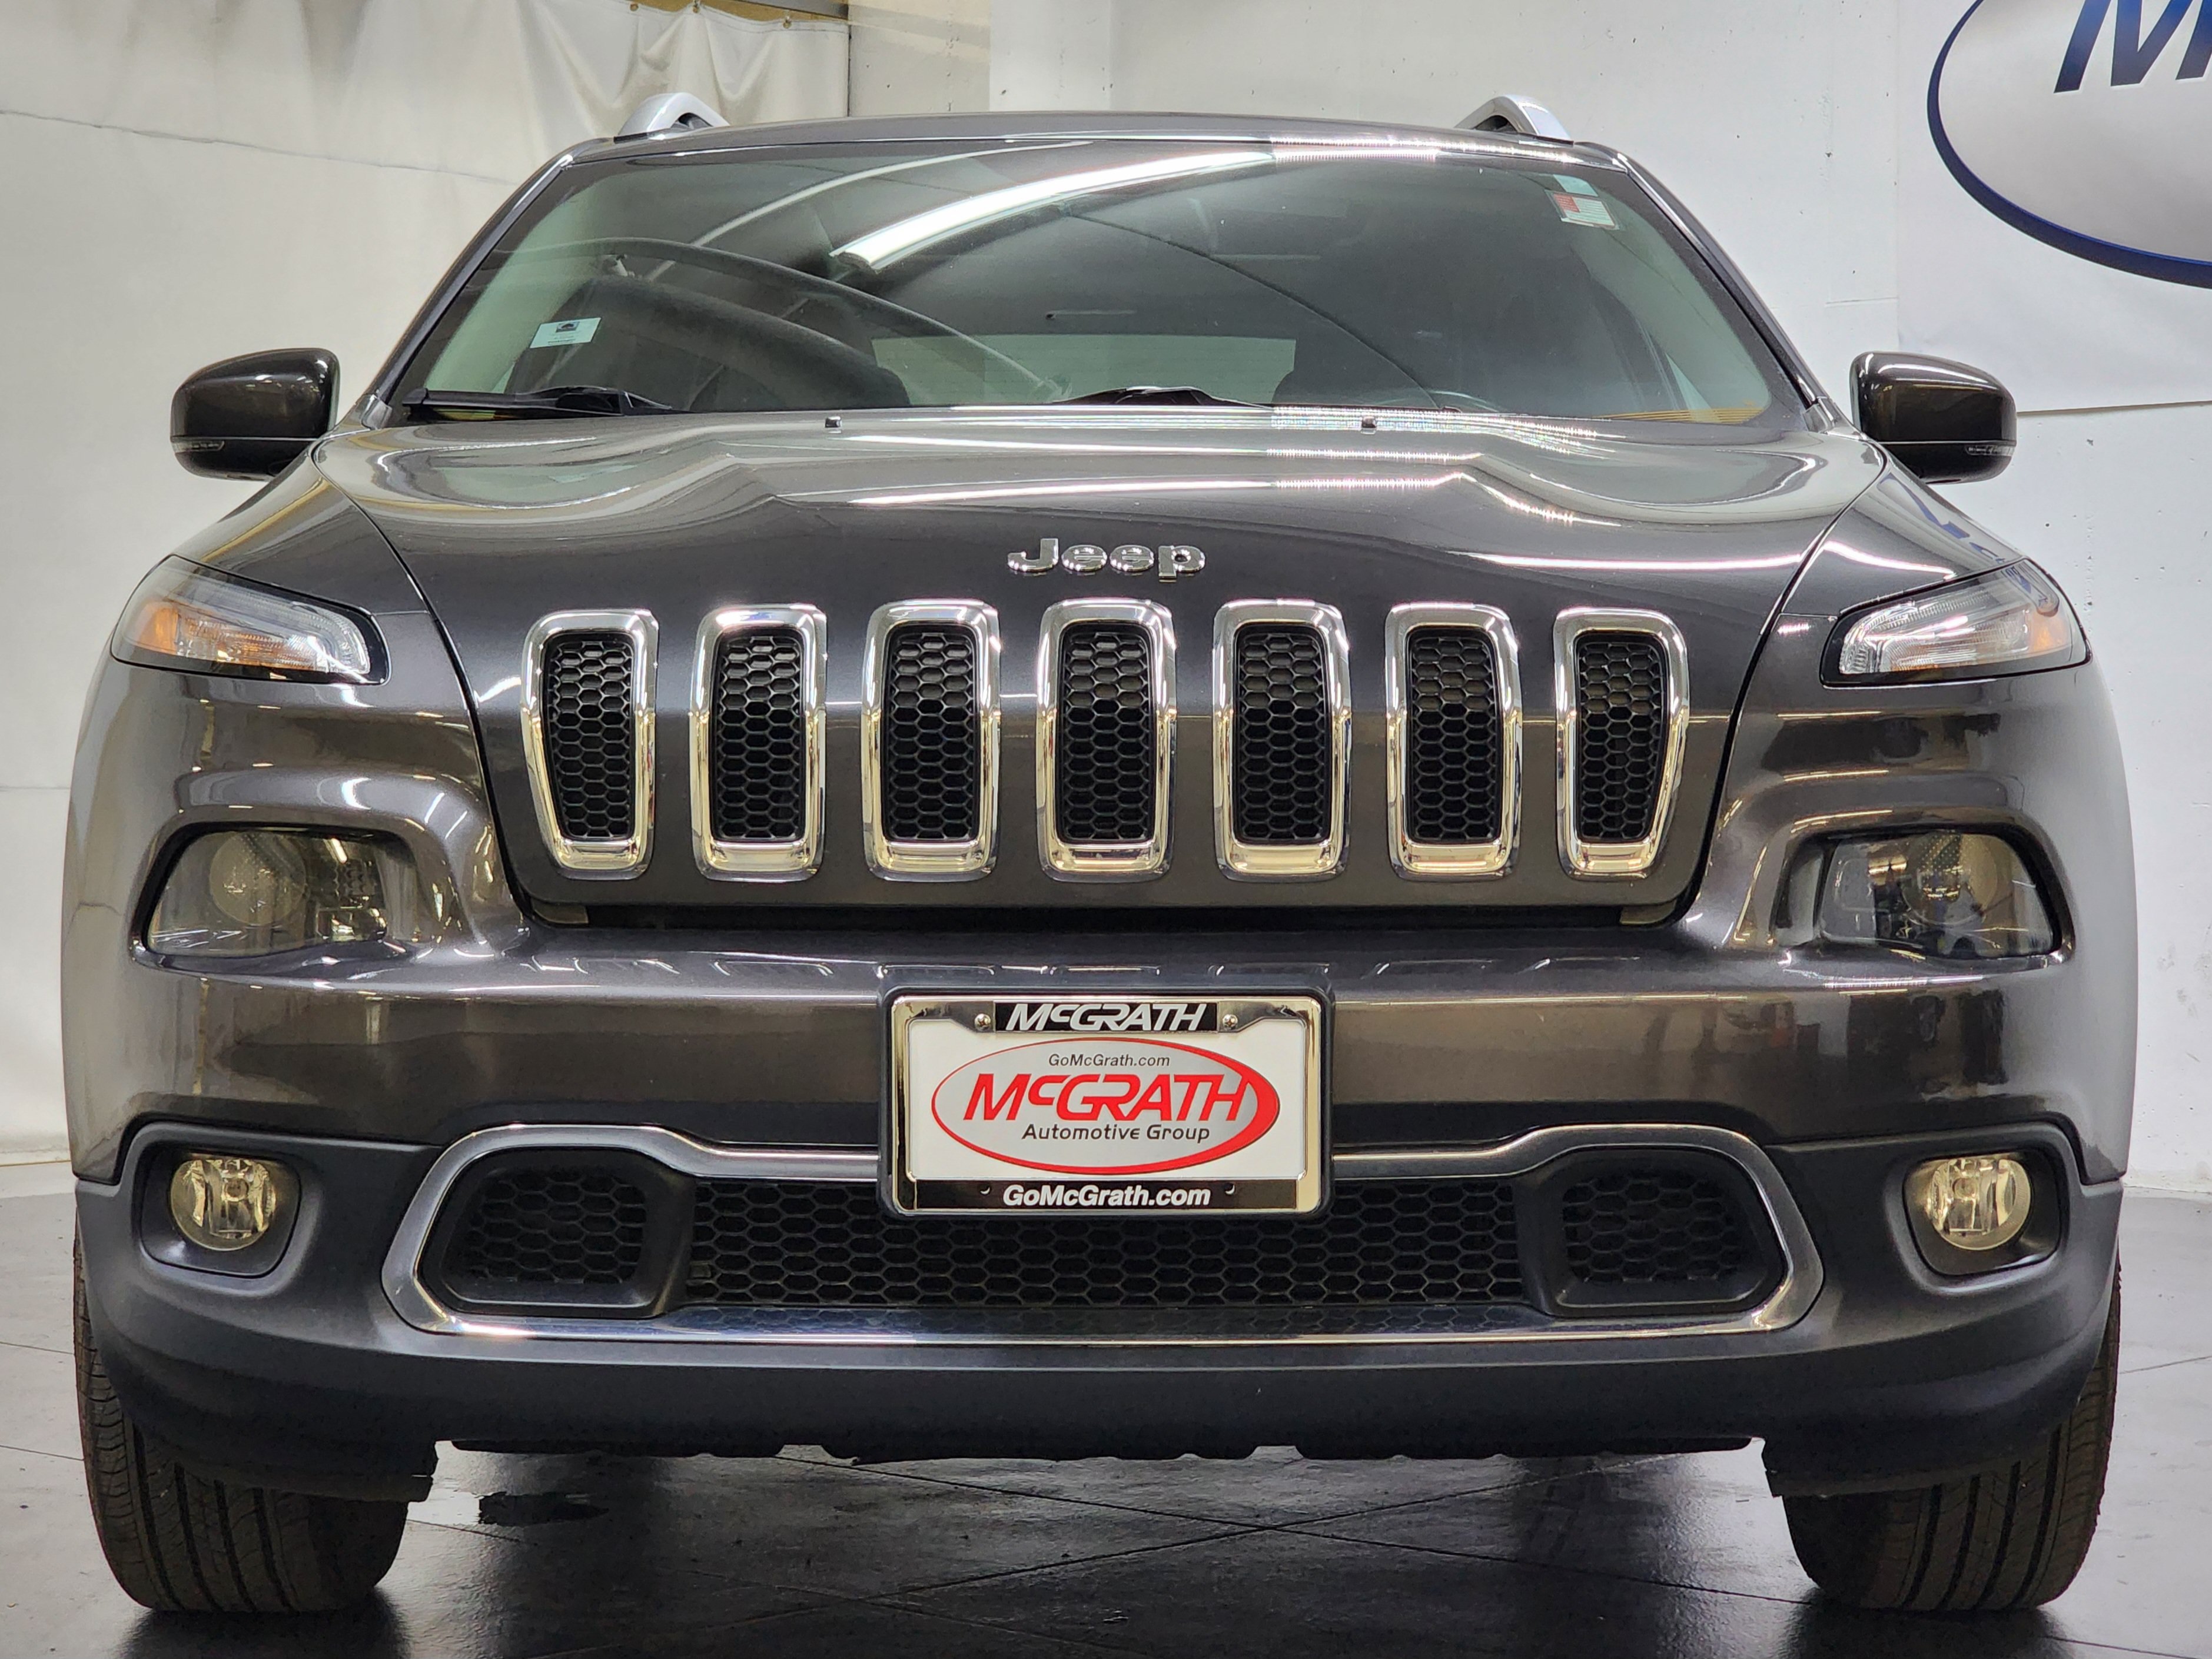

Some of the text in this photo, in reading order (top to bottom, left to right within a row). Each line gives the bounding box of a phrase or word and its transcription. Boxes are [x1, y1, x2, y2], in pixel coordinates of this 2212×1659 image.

[1007, 538, 1205, 578] Jeep
[1005, 1003, 1207, 1031] McGRATH
[1048, 1053, 1170, 1067] GoMcGrath.com
[963, 1073, 1247, 1121] McGRATH
[1022, 1124, 1210, 1143] Automotive Group
[1003, 1185, 1210, 1206] GoMcGrath.com
